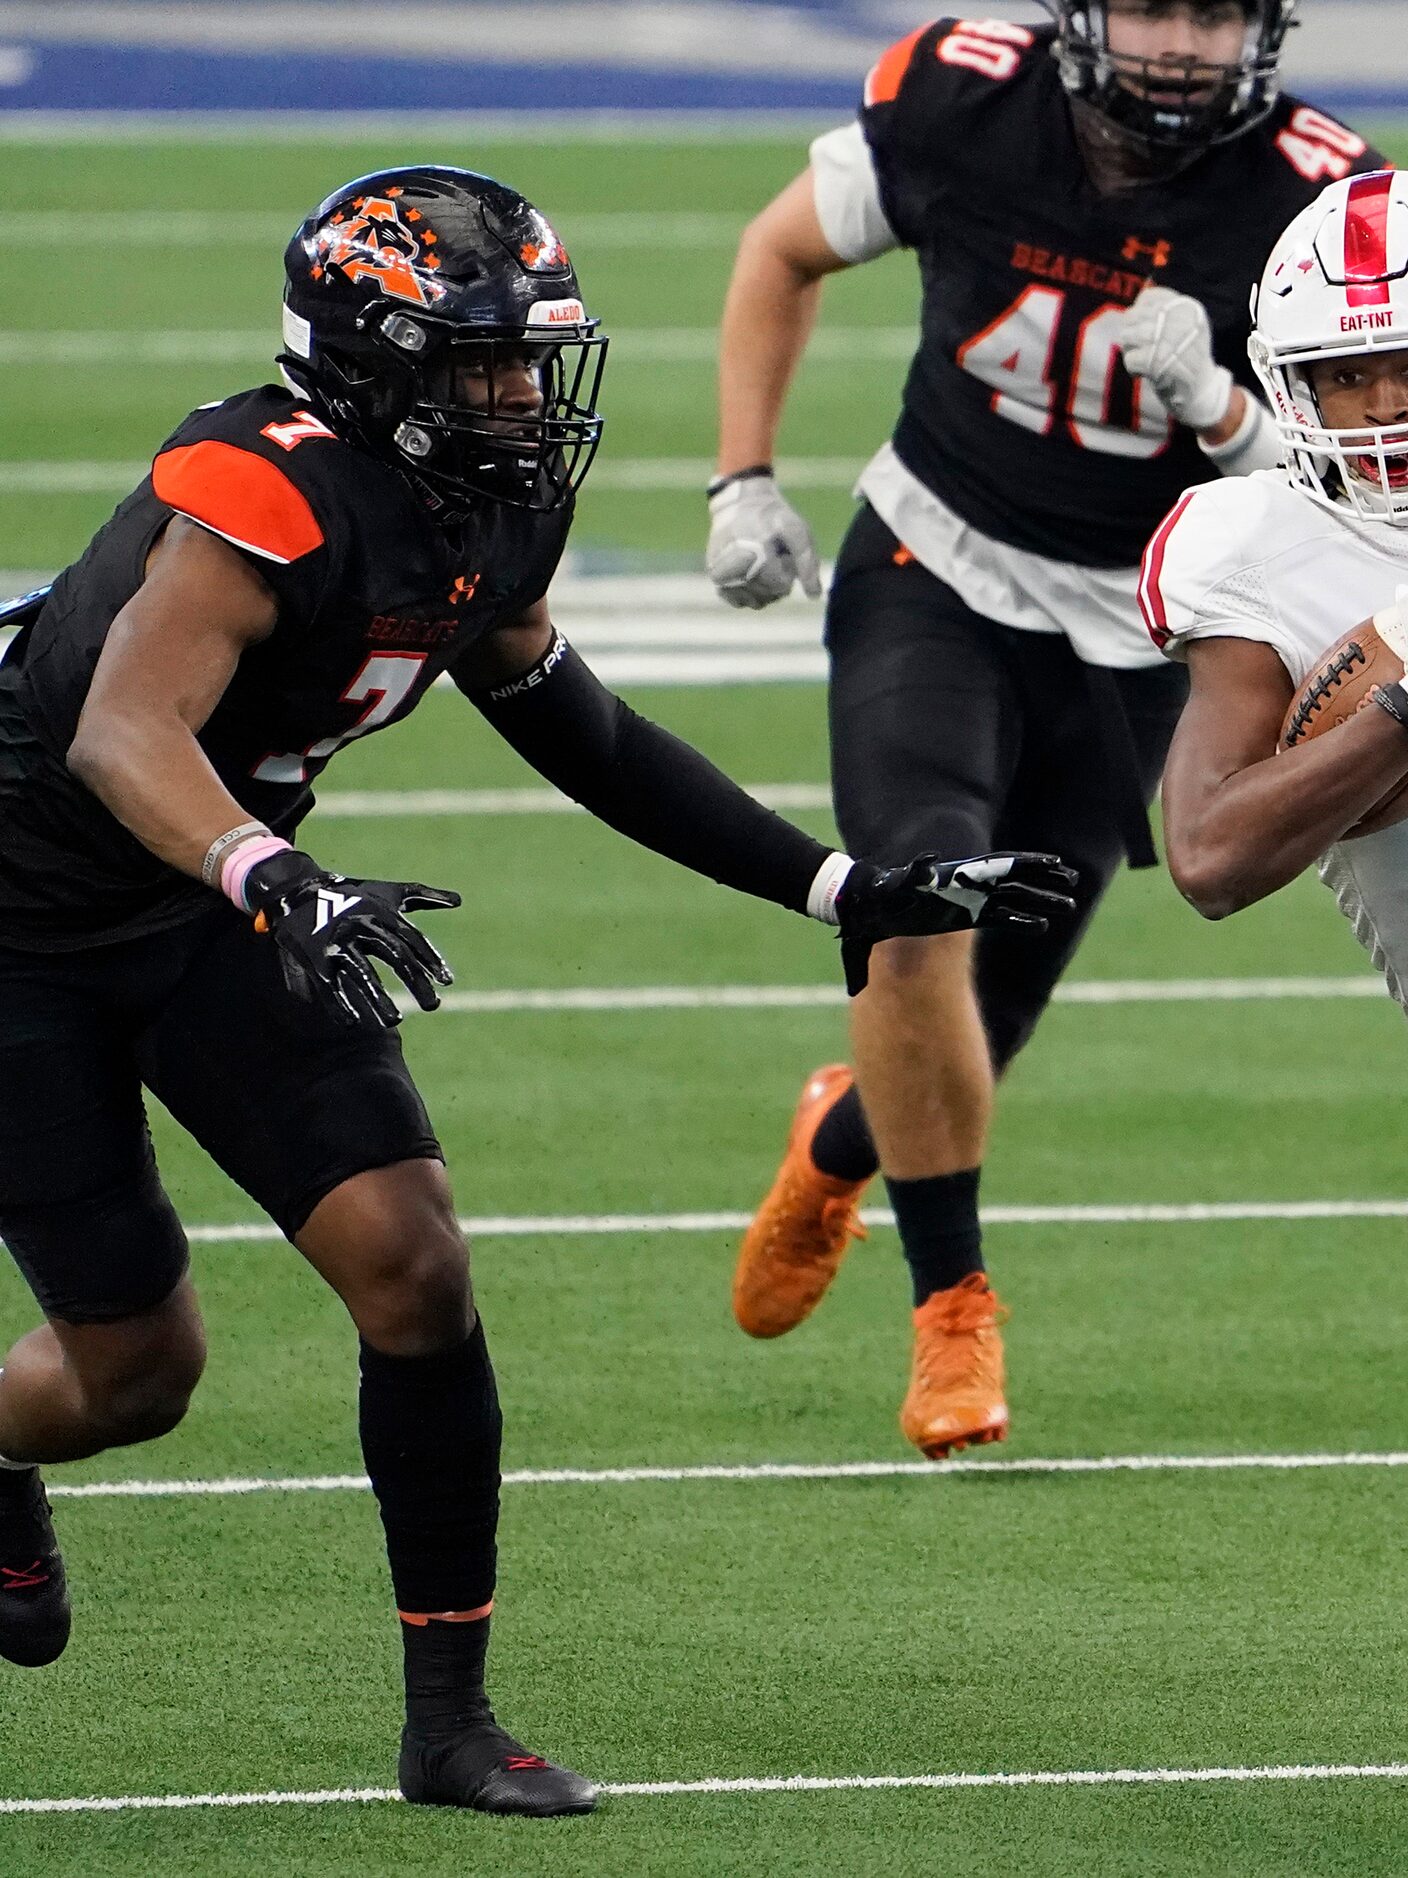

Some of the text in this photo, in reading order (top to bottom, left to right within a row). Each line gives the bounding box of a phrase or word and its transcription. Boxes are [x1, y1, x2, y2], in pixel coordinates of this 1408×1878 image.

[1274, 105, 1368, 182] 40
[1010, 242, 1153, 299] BEARCAT
[548, 304, 580, 322] ALEDO
[1340, 310, 1393, 332] EAT-TNT
[956, 283, 1173, 460] 40
[260, 410, 340, 452] 7
[490, 668, 543, 701] NIKE
[251, 649, 430, 783] 7
